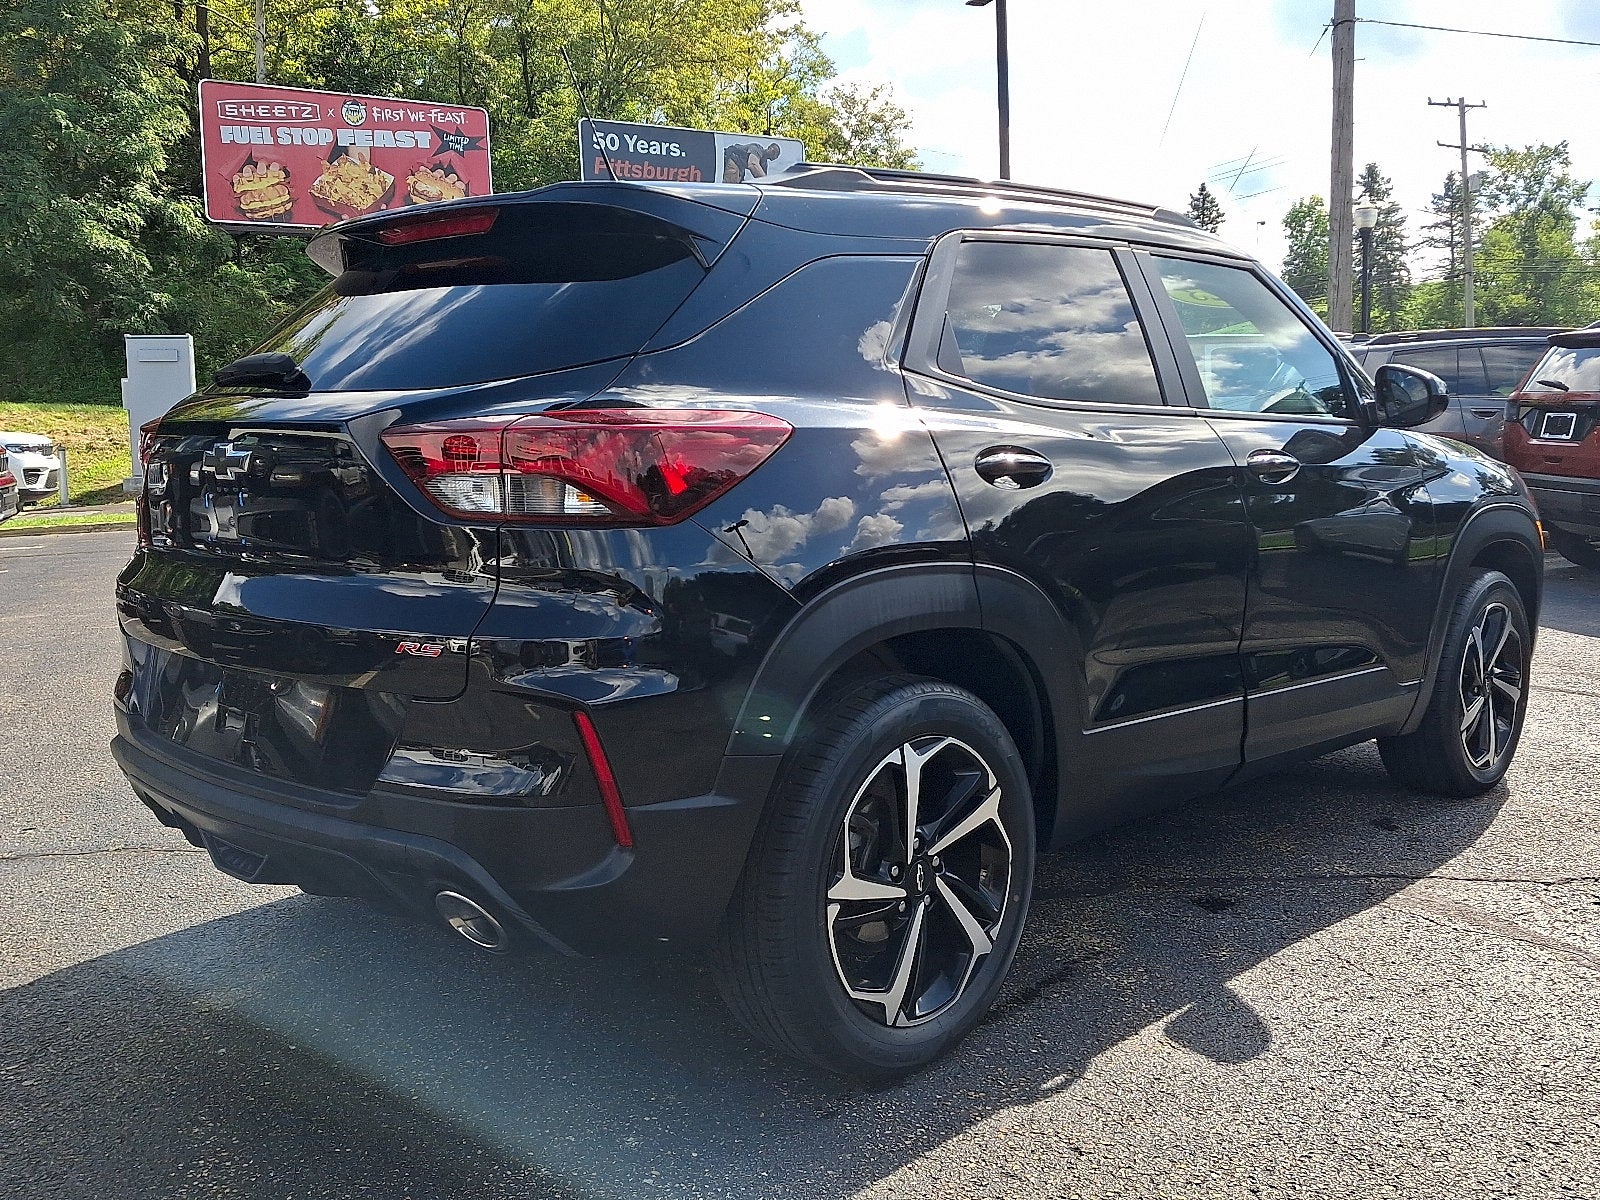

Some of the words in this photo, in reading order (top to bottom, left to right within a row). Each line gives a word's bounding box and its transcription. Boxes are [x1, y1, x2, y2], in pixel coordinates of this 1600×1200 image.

[224, 103, 313, 118] SHEETZ
[371, 106, 406, 123] FIRST
[406, 108, 426, 122] WE
[427, 108, 467, 125] FEAST
[219, 125, 274, 145] FUEL
[276, 127, 334, 146] STOP
[336, 128, 432, 149] FEAST
[443, 133, 470, 145] LIMITED
[448, 141, 465, 152] TIME
[592, 131, 620, 151] 50
[623, 133, 687, 157] Years.
[395, 641, 444, 657] RS
